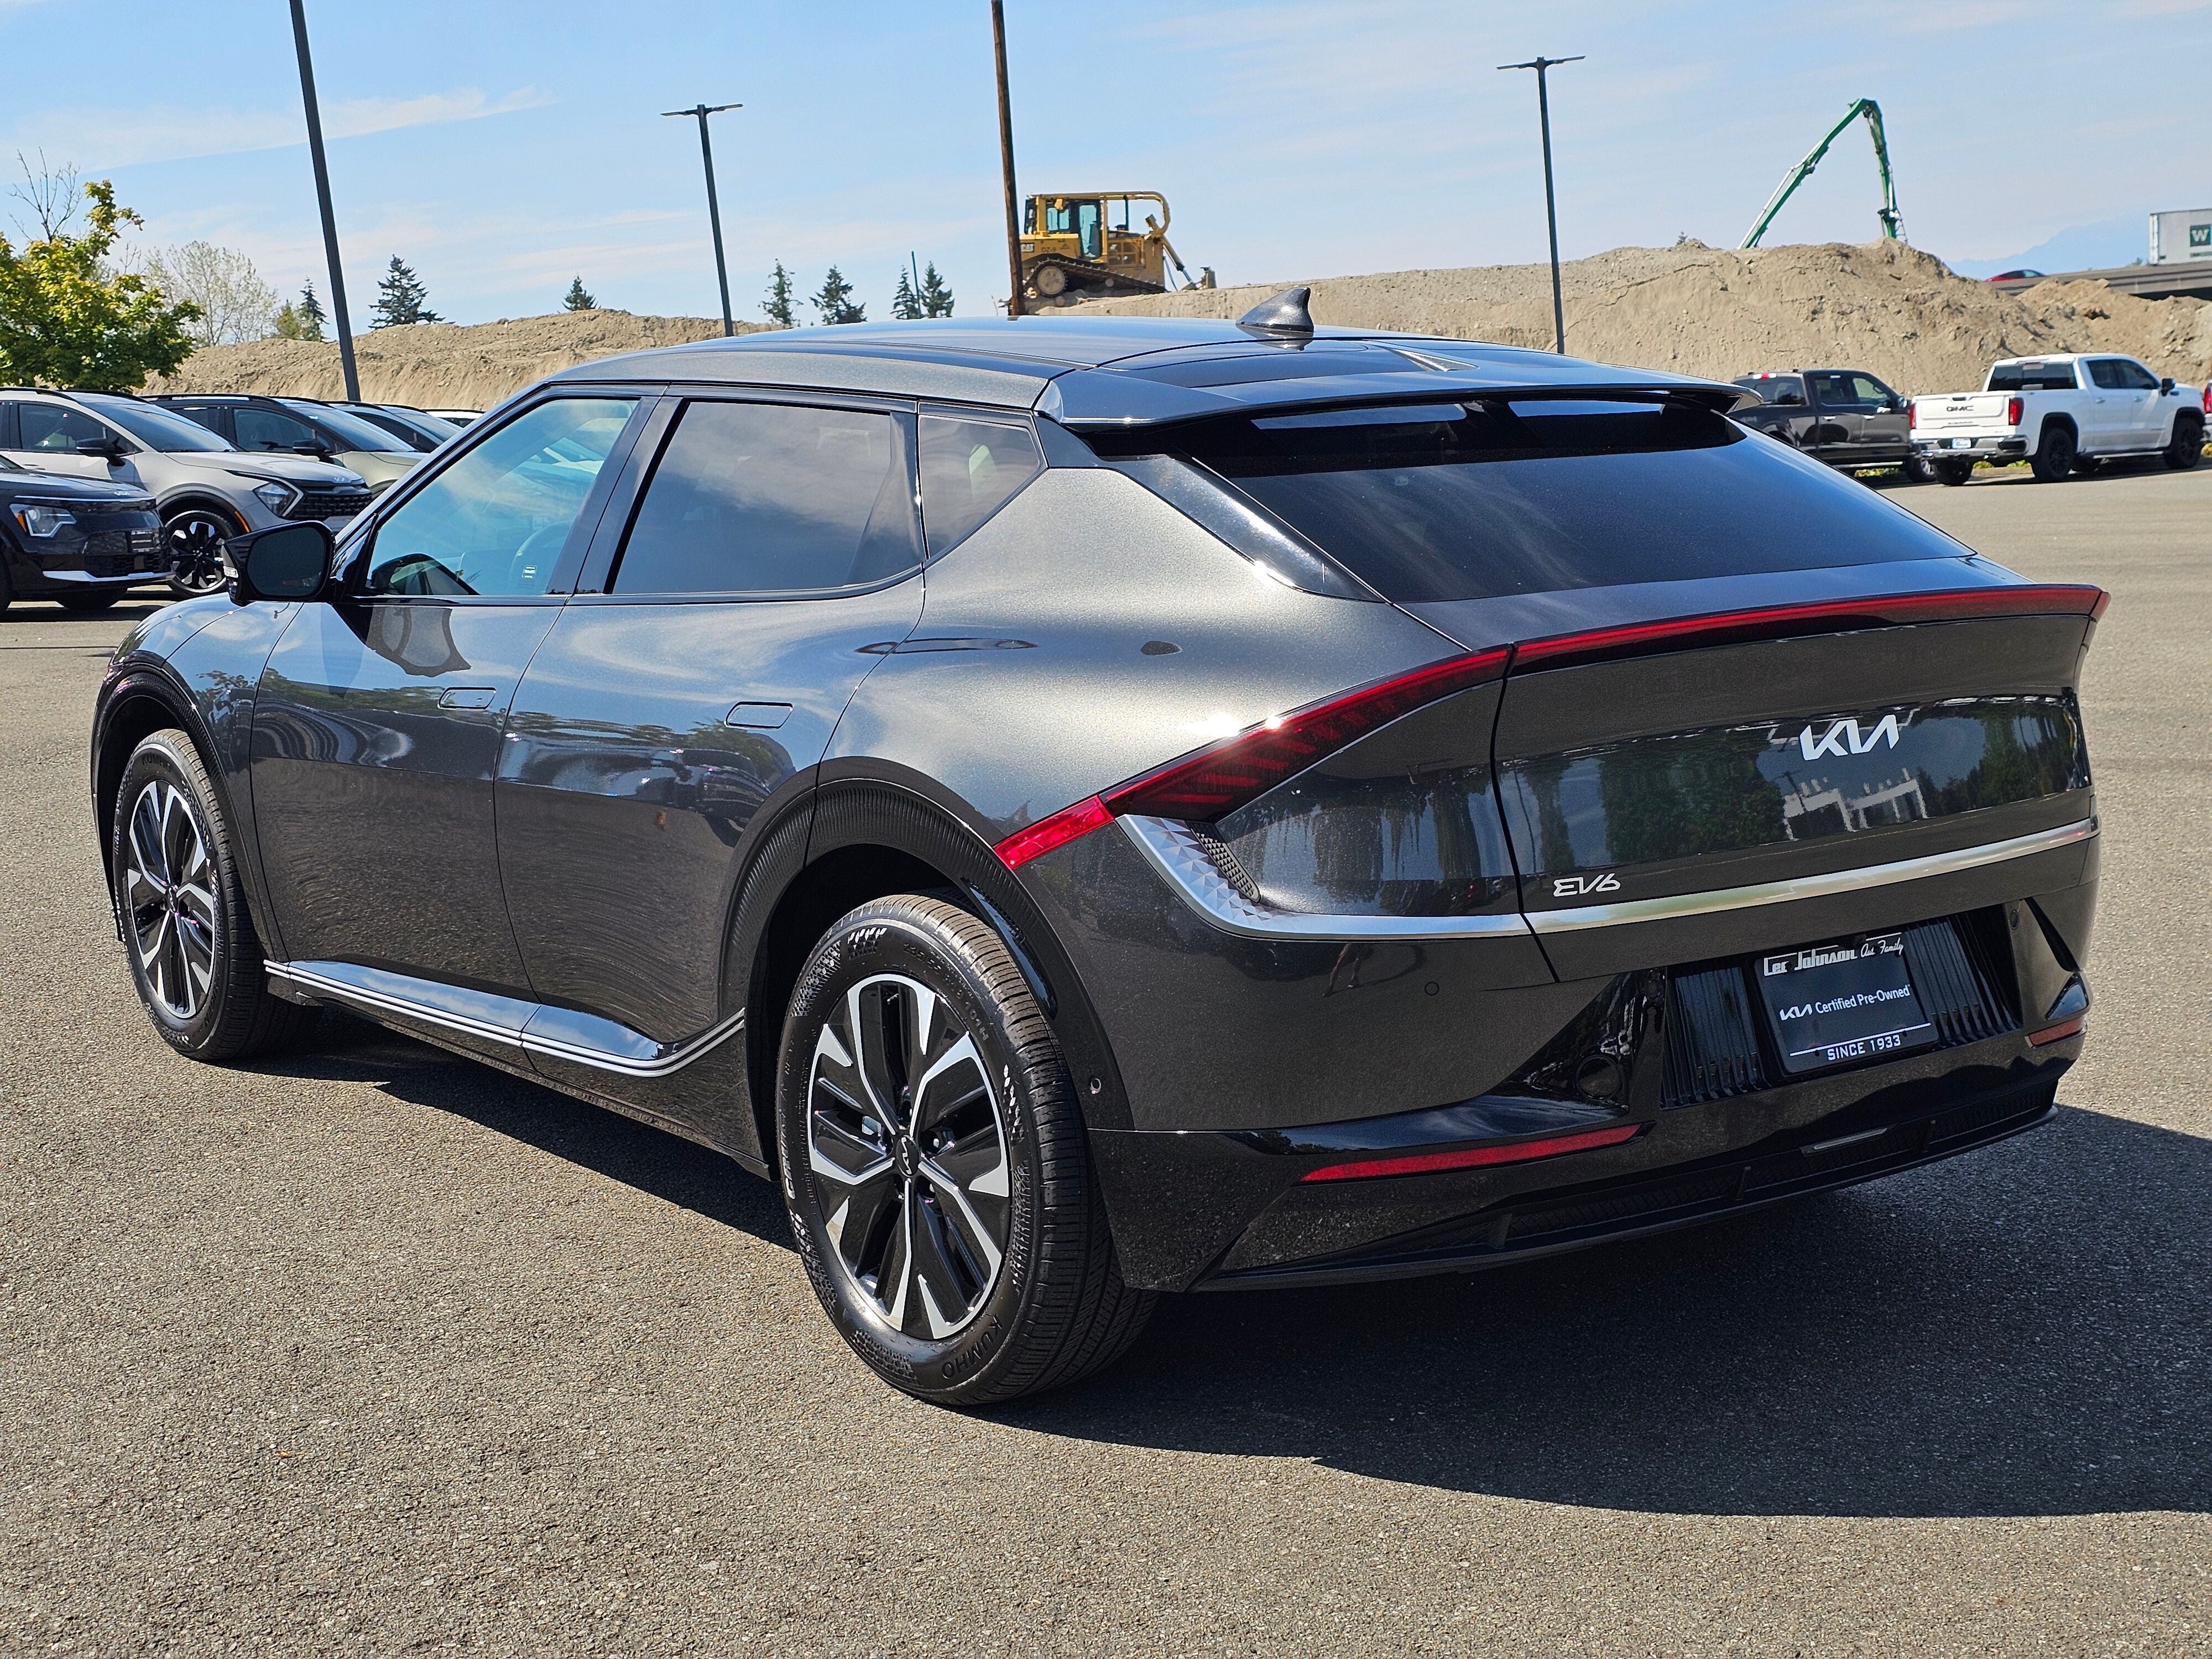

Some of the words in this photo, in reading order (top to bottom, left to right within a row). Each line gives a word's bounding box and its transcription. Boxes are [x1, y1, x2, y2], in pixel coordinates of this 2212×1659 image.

[2191, 228, 2209, 242] W
[1799, 714, 1900, 761] KIA
[1553, 873, 1621, 897] EV6
[1877, 937, 1905, 956] Family
[1779, 1003, 1813, 1021] KIA
[1815, 995, 1858, 1014] Certified
[1856, 984, 1911, 1006] Pre-Owned
[1827, 1042, 1866, 1061] SINCE
[1870, 1034, 1902, 1052] 1933
[941, 1313, 1003, 1379] KUMHO
